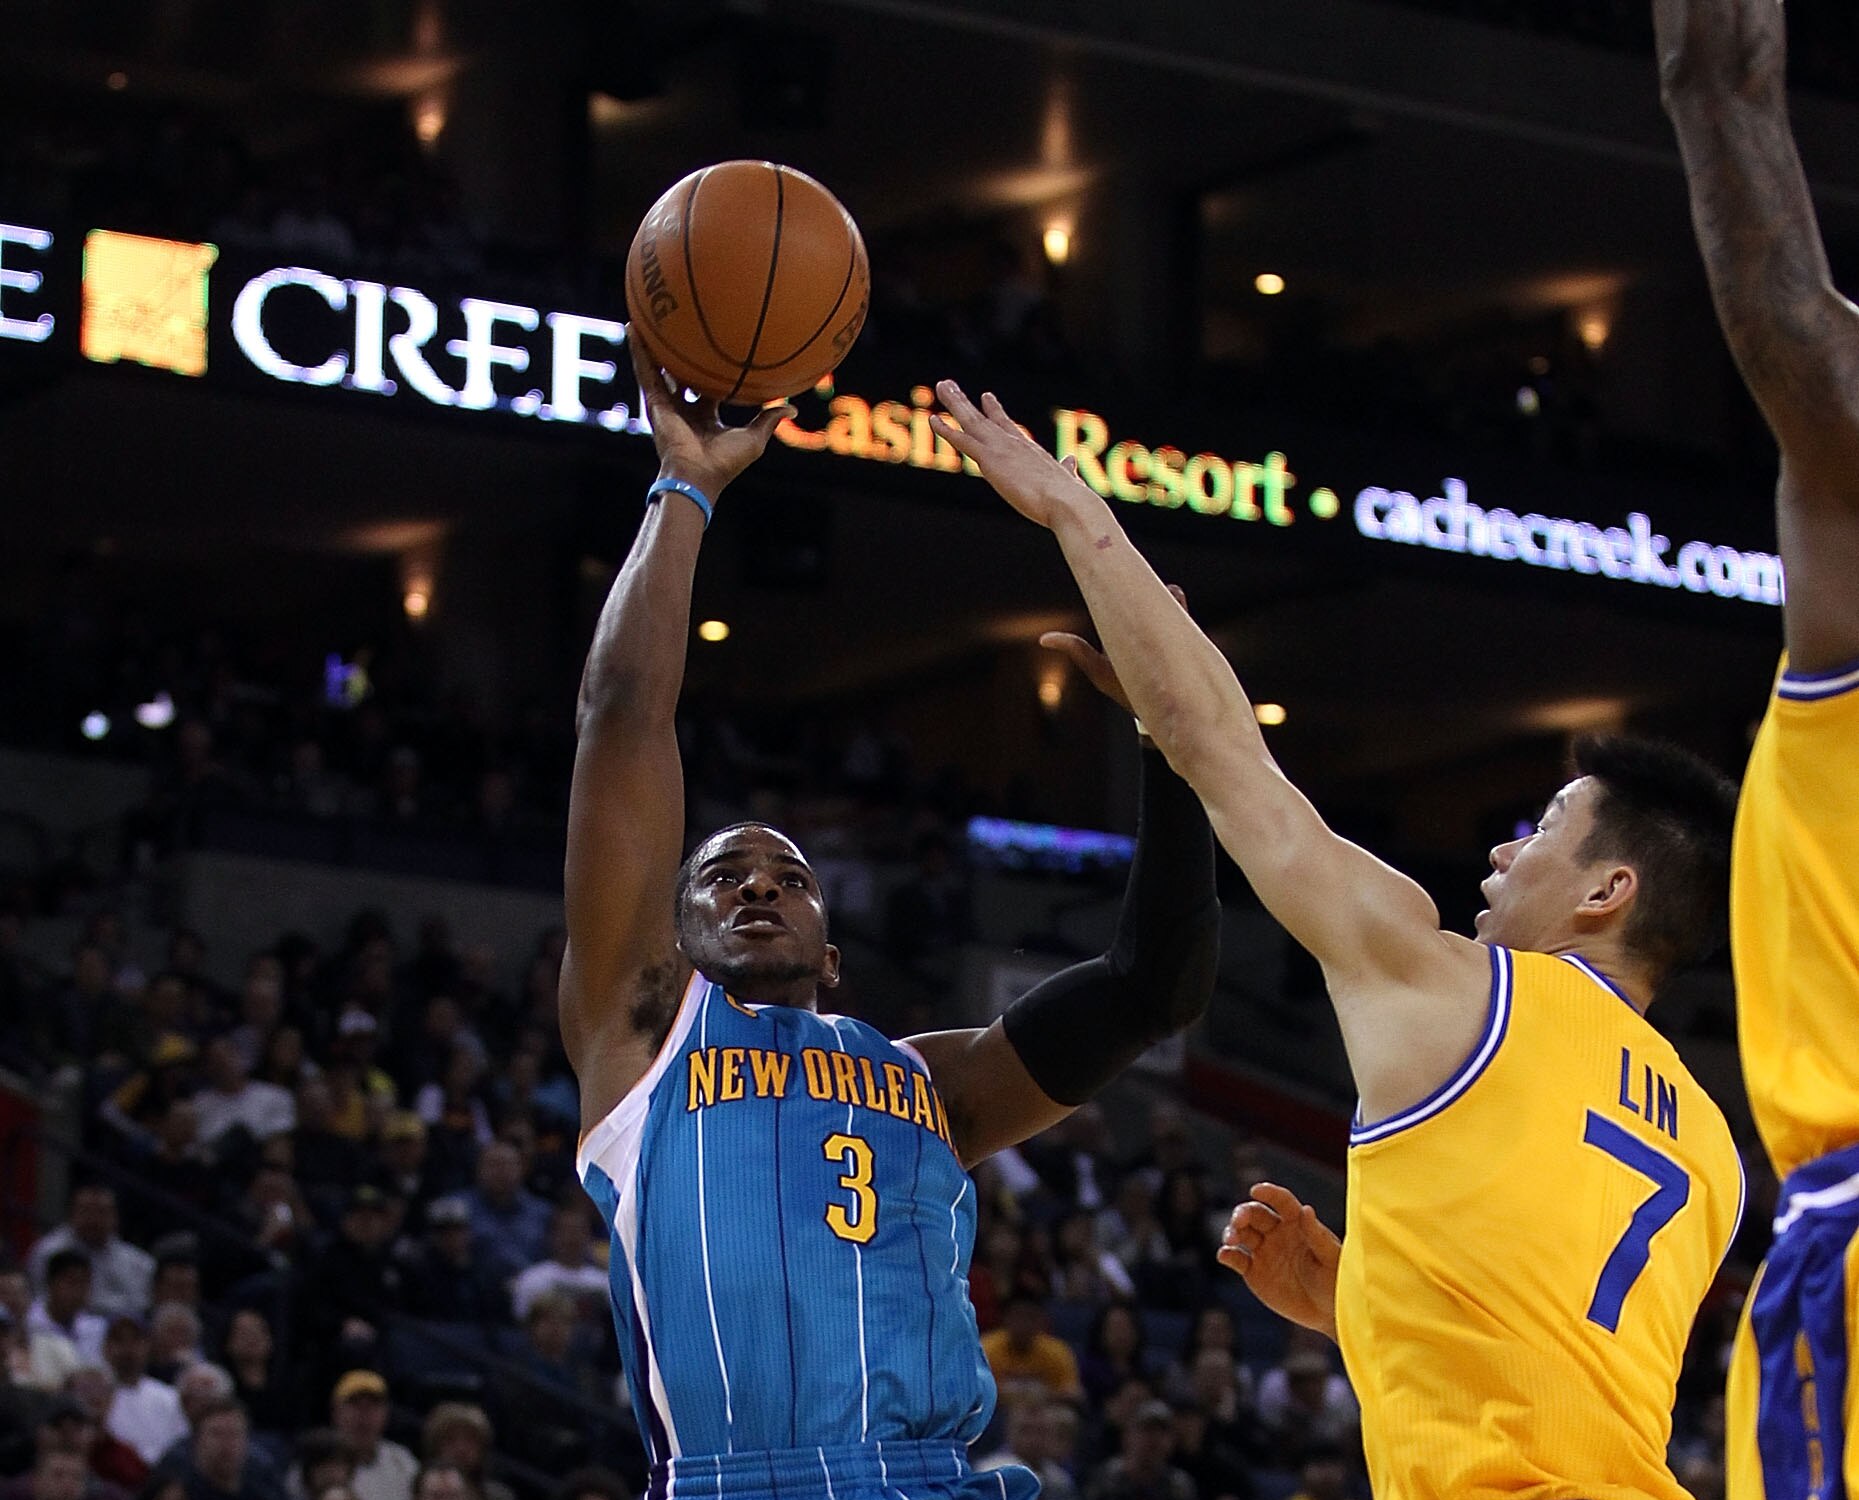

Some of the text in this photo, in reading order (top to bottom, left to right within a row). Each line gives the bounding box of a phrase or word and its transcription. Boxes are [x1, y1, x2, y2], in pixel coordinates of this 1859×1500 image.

[231, 266, 653, 435] CREE
[764, 372, 1036, 476] asin
[1055, 408, 1297, 527] Resort
[686, 1047, 791, 1113] NEW
[1618, 1046, 1678, 1141] LIN
[822, 1132, 879, 1244] 3
[1583, 1108, 1690, 1334] 7
